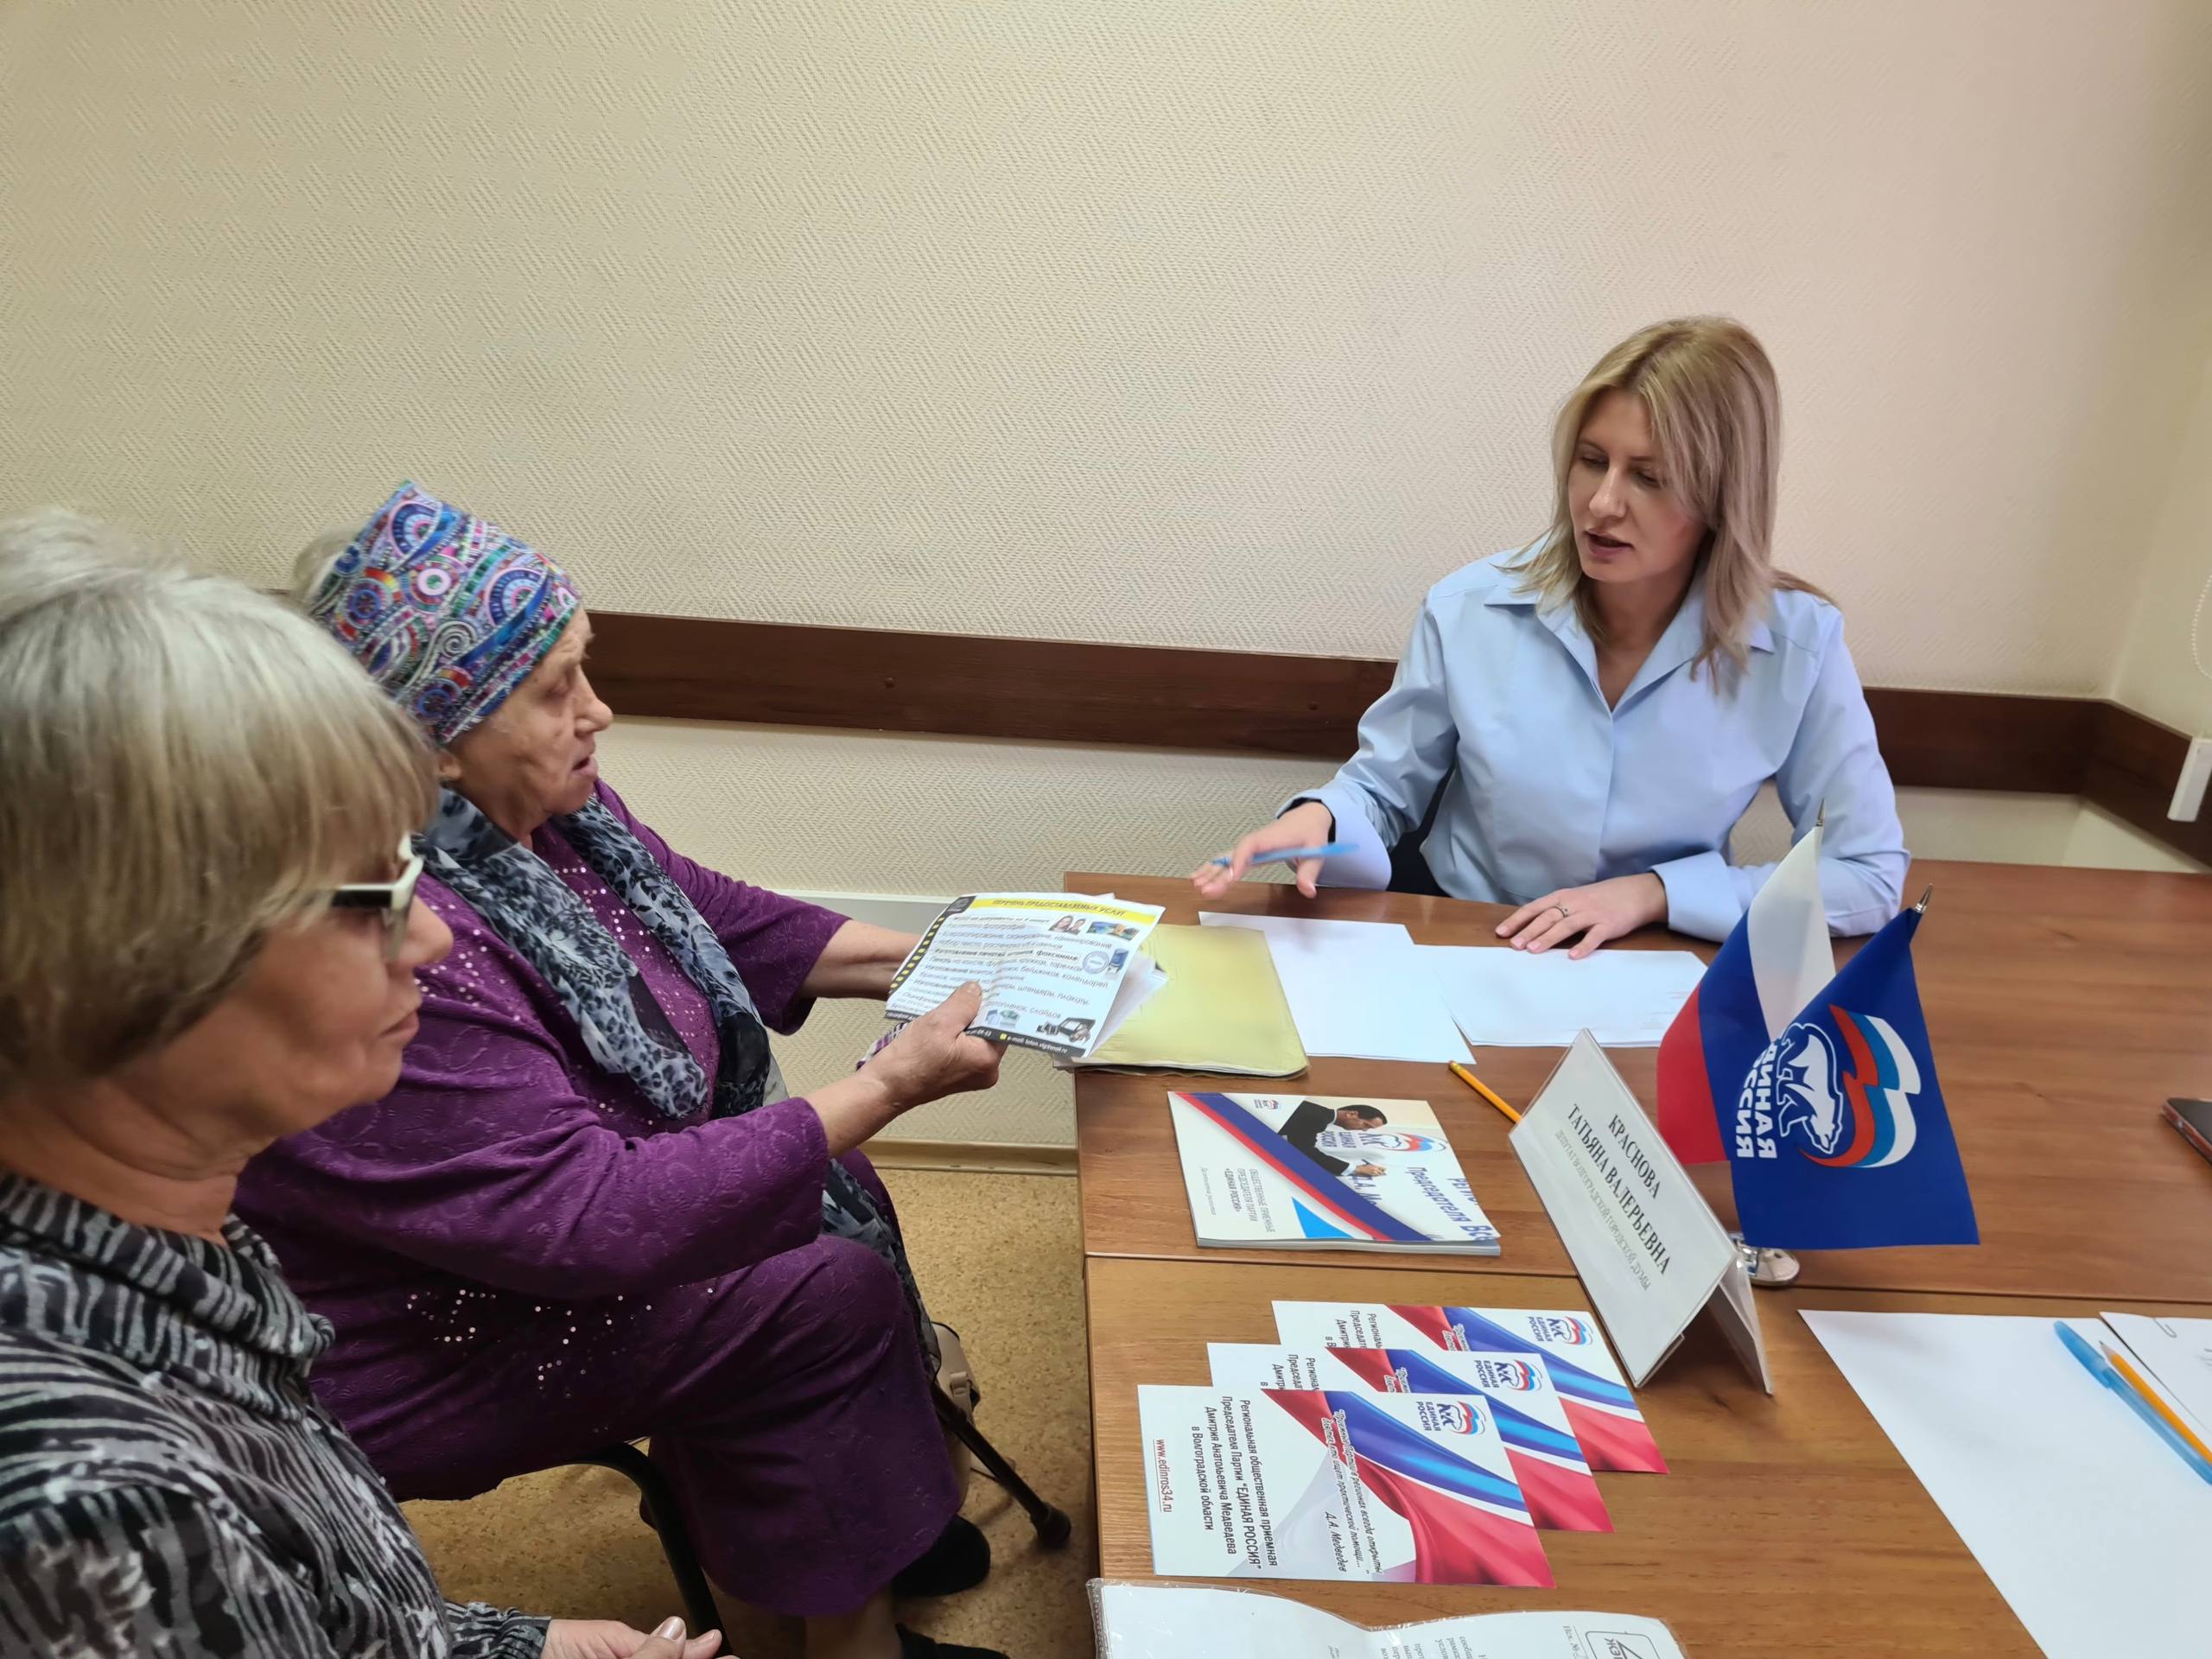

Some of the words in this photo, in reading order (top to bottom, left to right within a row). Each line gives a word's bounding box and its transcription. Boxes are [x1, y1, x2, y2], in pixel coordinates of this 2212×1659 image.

[1736, 1048, 1768, 1159] ССИЯ
[1755, 1043, 1777, 1159] ДИНАЯ
[1608, 1115, 1662, 1199] КРАСНОВА
[1405, 1167, 1472, 1222] Председателя
[1567, 1103, 1611, 1173] ТАТЬЯНА
[1605, 1166, 1672, 1275] ВАЛЕРЬЕВНА
[1527, 1316, 1544, 1342] РОССИЯ
[1535, 1317, 1554, 1342] ЕДИНАЯ
[1474, 1360, 1491, 1388] РОССИЯ
[1484, 1360, 1500, 1388] ЕДИНАЯ
[1205, 1407, 1221, 1440] Дмитрия
[1220, 1396, 1240, 1450] Председателя
[1415, 1402, 1432, 1431] РОССИЯ
[1426, 1402, 1441, 1431] ЕДИНАЯ
[1156, 1440, 1174, 1512] www.edinros34.ru
[1192, 1433, 1211, 1493] Волгоградской
[1211, 1442, 1230, 1500] Анатольевича
[1229, 1452, 1243, 1481] Партии
[1240, 1400, 1257, 1453] Региональная
[1250, 1455, 1269, 1517] общественная
[1260, 1519, 1278, 1566] приемная
[1333, 1460, 1343, 1479] ищет
[1201, 1496, 1215, 1530] области
[1220, 1502, 1236, 1554] Медведева
[1337, 1480, 1358, 1529] практической
[1350, 1477, 1364, 1509] регионах
[1360, 1510, 1374, 1535] всегда
[1367, 1535, 1383, 1574] открыты
[1324, 1511, 1337, 1529] Д.А.
[1331, 1531, 1347, 1572] Медведев
